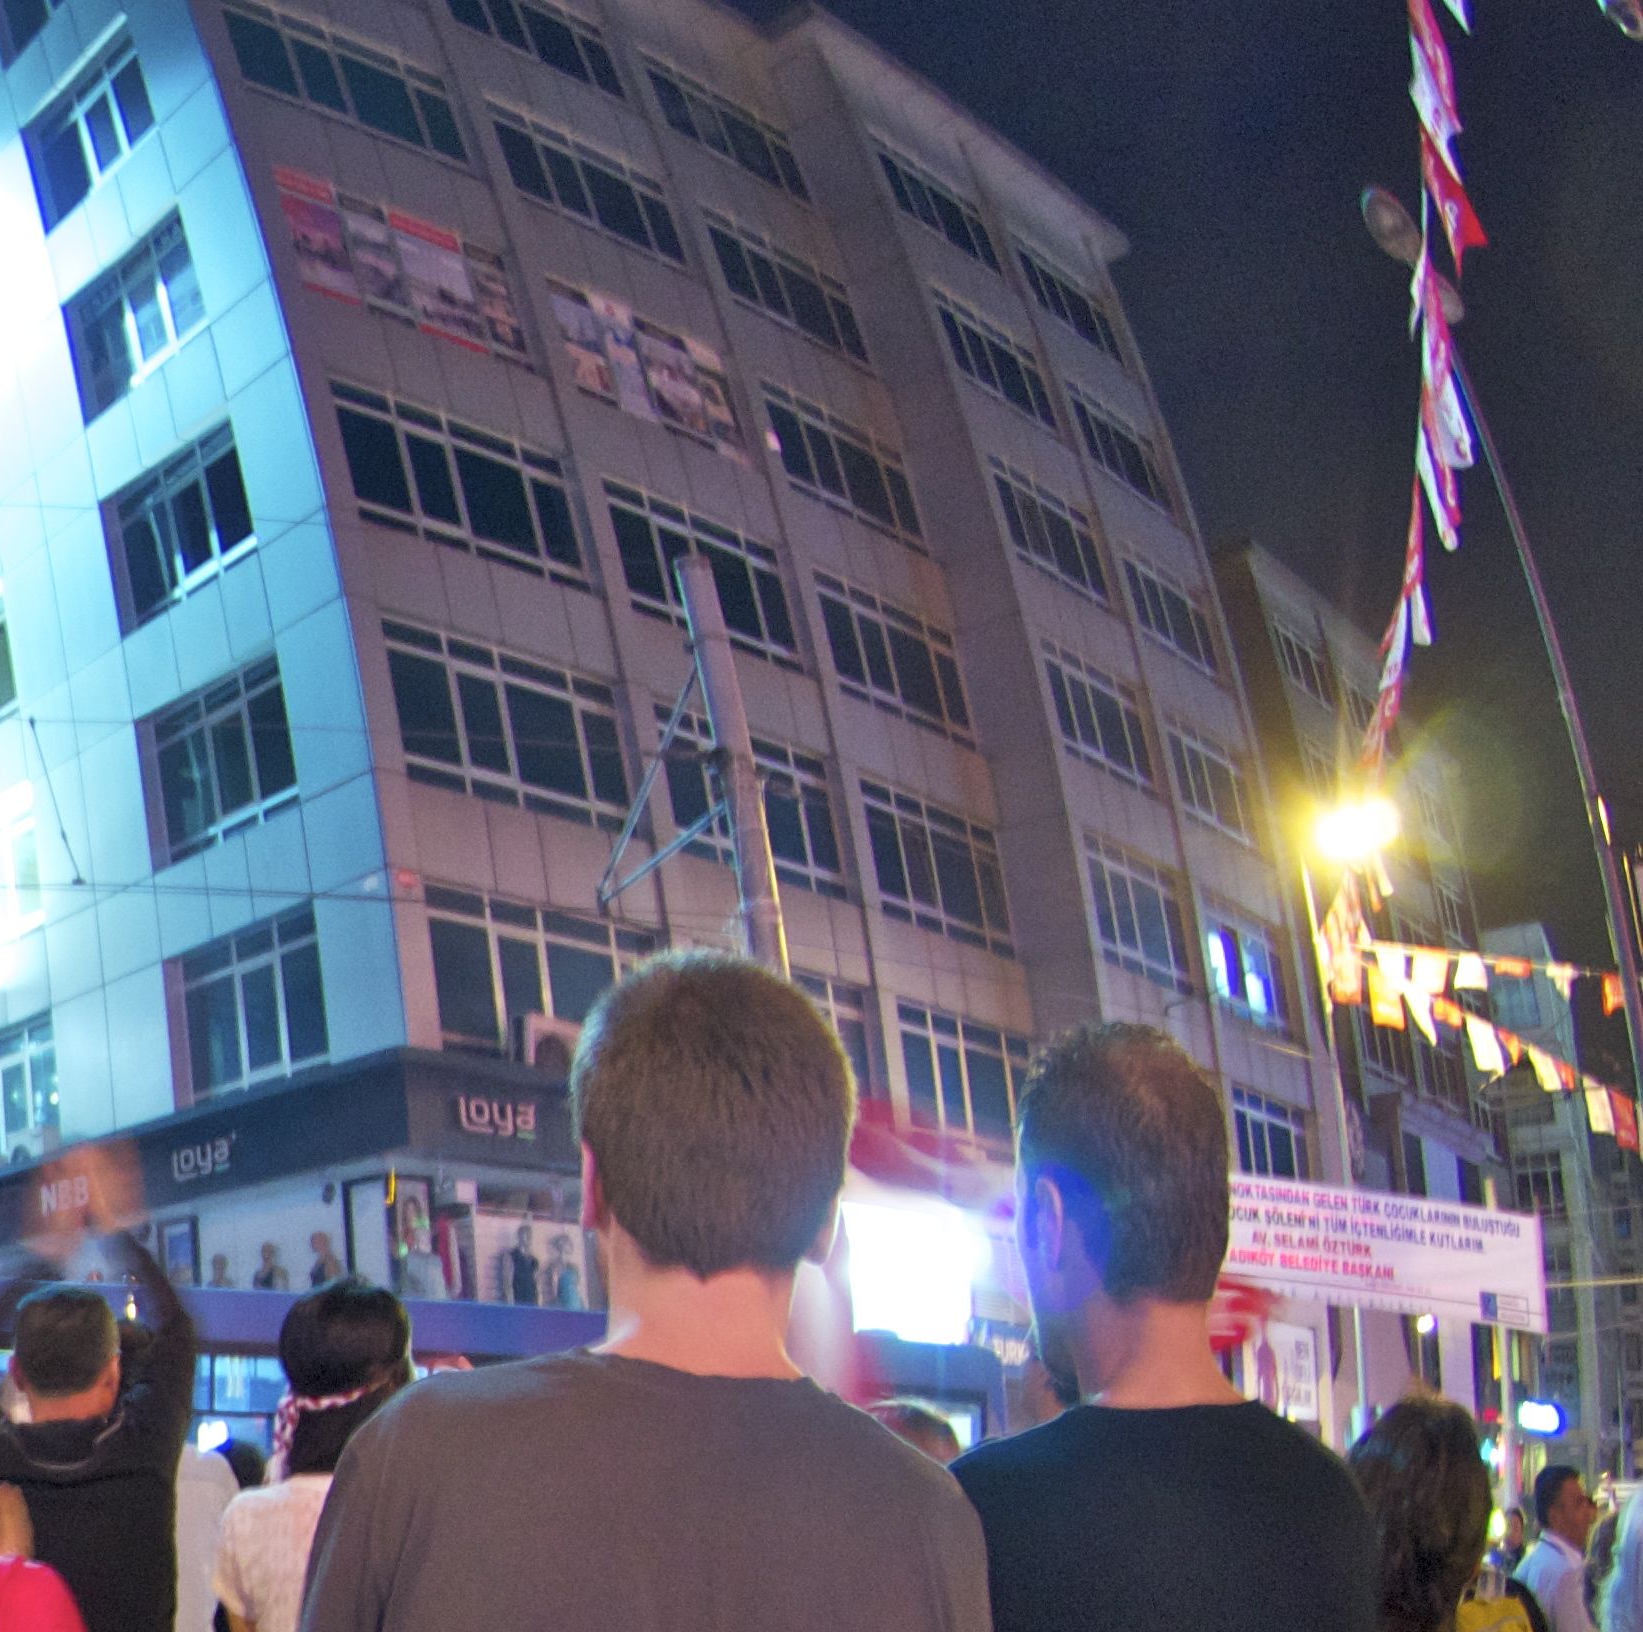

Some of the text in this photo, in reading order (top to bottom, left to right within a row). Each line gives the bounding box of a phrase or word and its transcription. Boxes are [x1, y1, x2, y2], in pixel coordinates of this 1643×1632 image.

[1313, 1192, 1348, 1211] GELEN
[1352, 1196, 1379, 1214] TÜRK
[1324, 1216, 1347, 1234] TÜM
[1323, 1235, 1372, 1257] ÖZTÜRK
[1279, 1252, 1340, 1275] BELEDİYE
